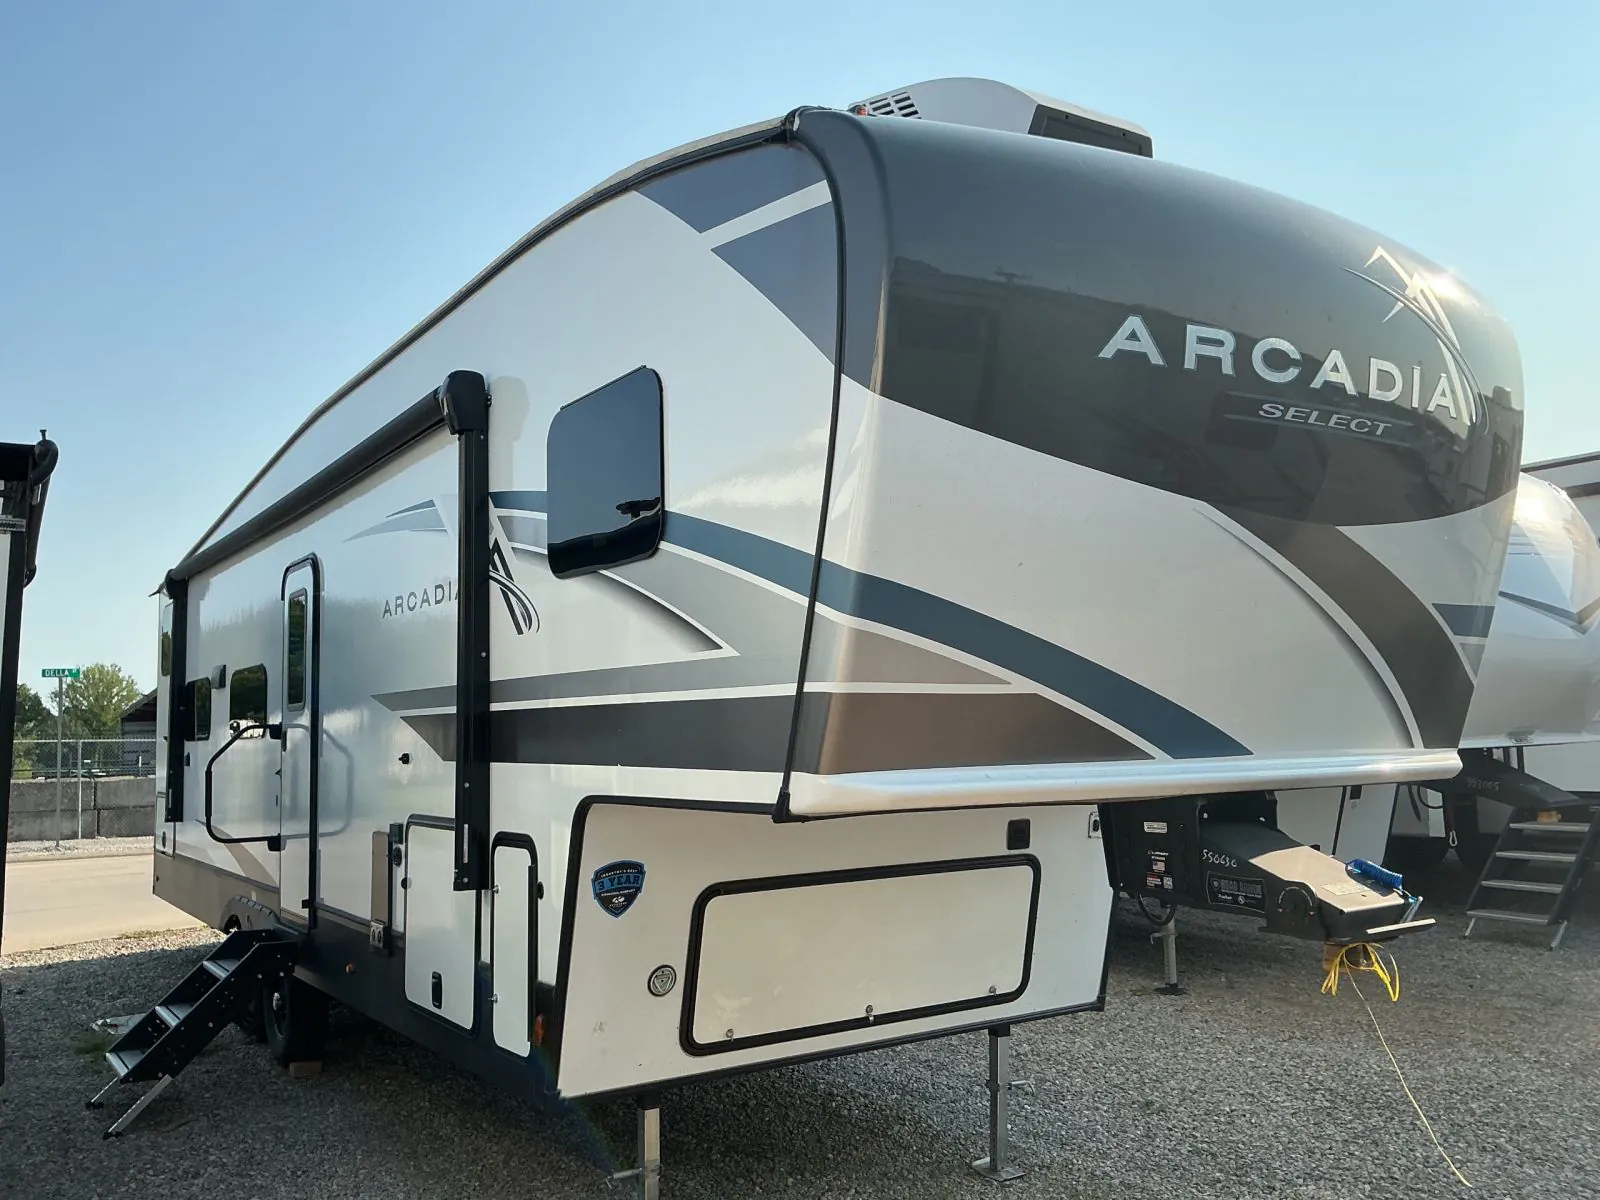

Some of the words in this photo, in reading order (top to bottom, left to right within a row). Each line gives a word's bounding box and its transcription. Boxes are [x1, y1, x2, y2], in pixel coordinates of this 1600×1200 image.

[1098, 313, 1458, 420] ARCADIA
[1258, 403, 1393, 437] SELECT
[45, 669, 70, 677] DELLA
[598, 880, 605, 891] 3
[608, 875, 640, 888] YEAR
